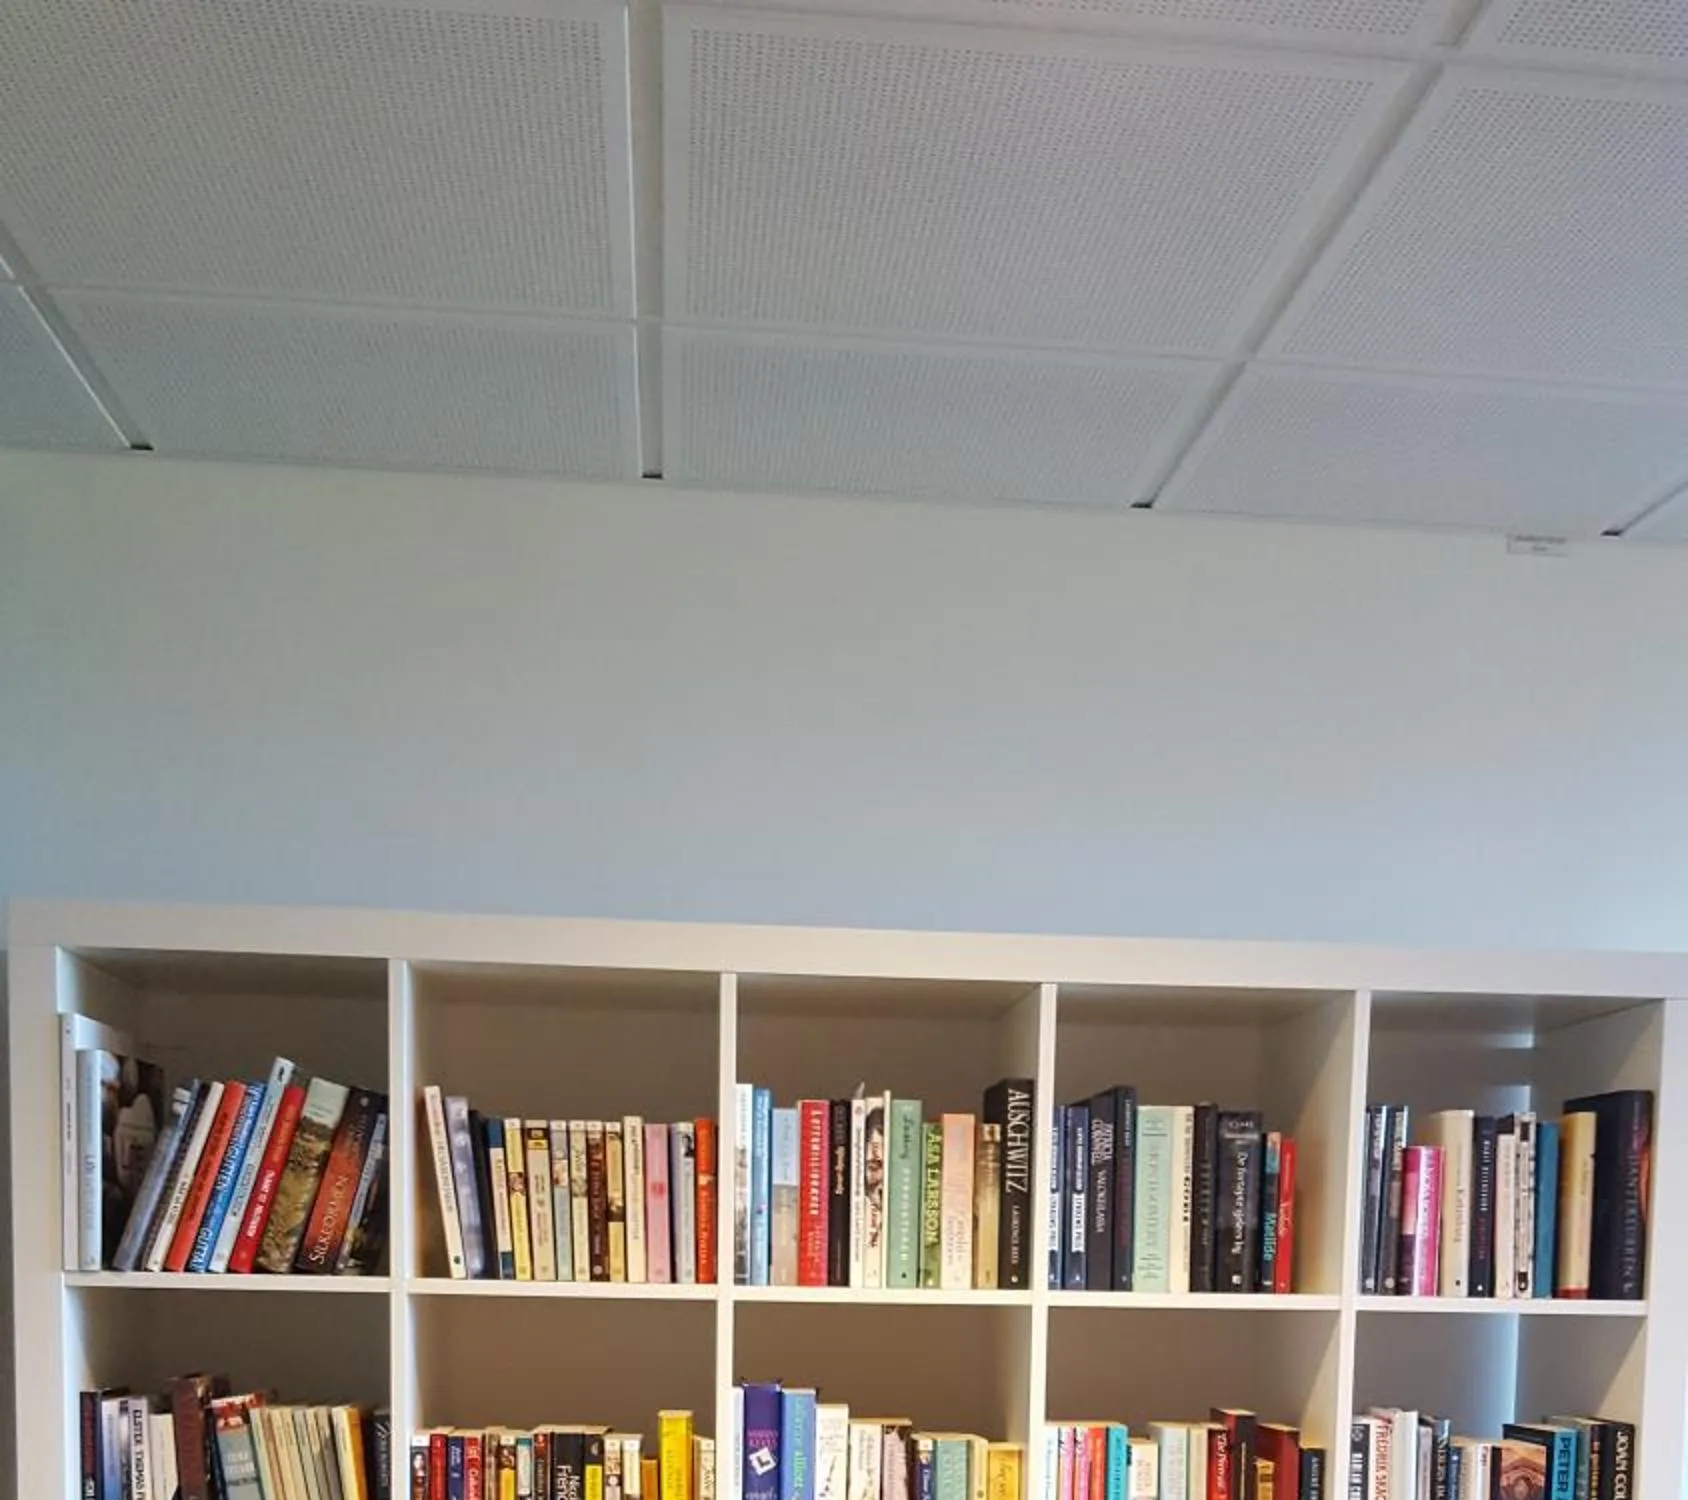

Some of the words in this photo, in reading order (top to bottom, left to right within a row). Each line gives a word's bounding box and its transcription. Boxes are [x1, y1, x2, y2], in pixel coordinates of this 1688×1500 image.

[1005, 1087, 1030, 1194] AUSCHWITZ
[926, 1167, 940, 1245] LARSSON
[1264, 1212, 1277, 1261] Matilde
[1557, 1437, 1572, 1493] PETER
[1615, 1431, 1628, 1471] JOAN
